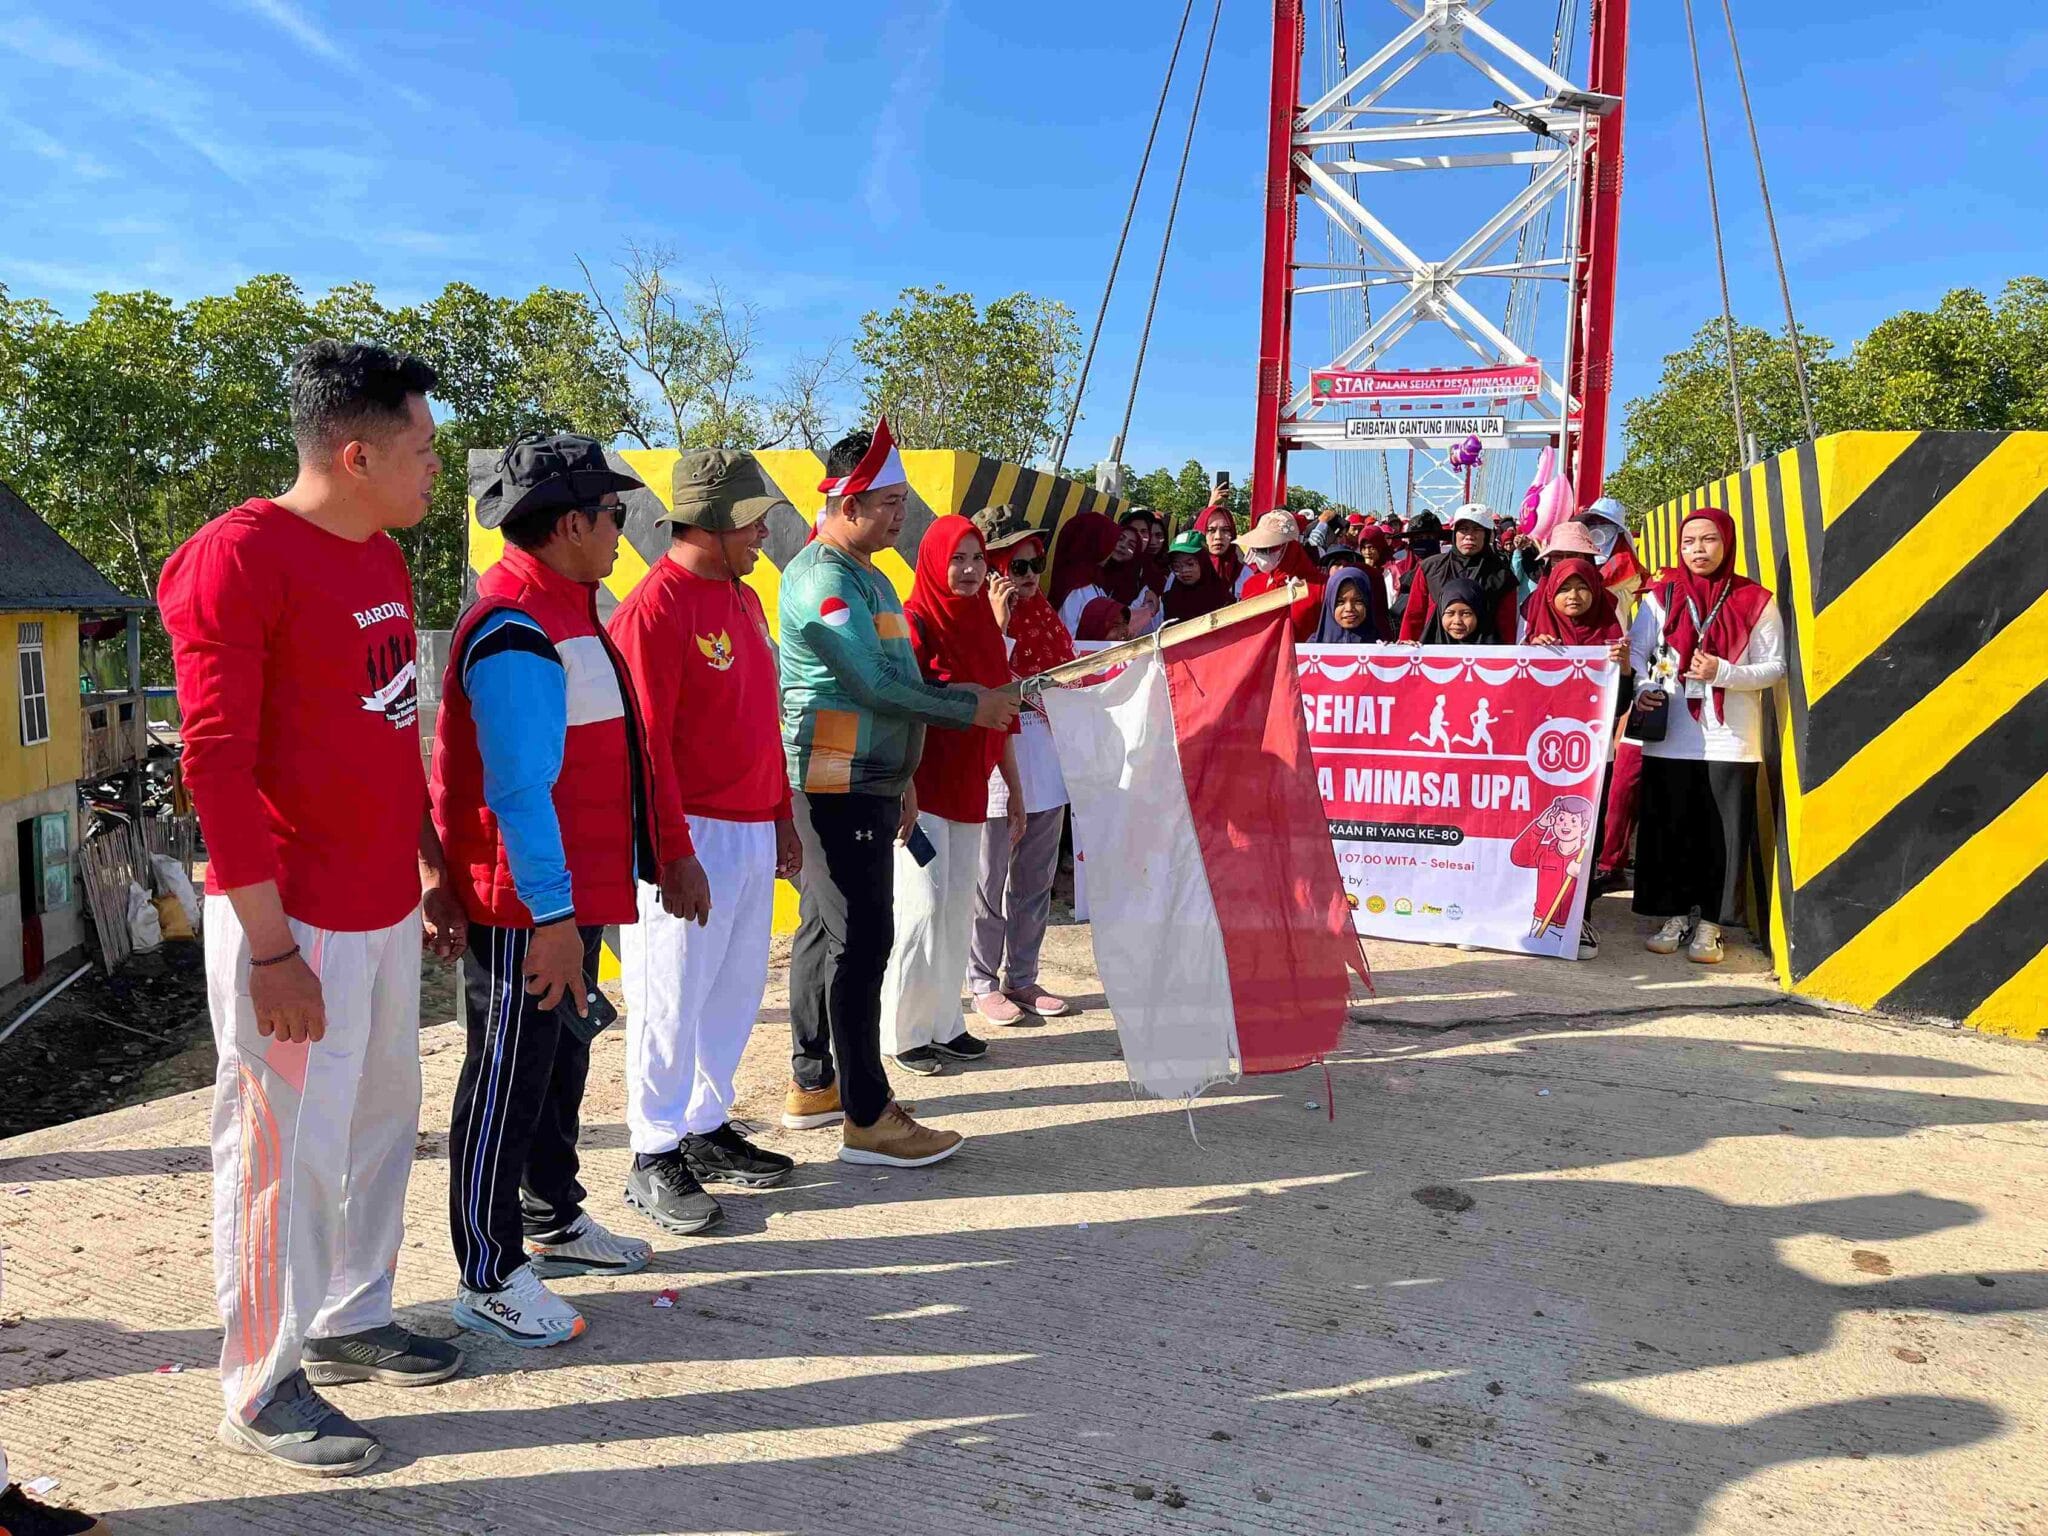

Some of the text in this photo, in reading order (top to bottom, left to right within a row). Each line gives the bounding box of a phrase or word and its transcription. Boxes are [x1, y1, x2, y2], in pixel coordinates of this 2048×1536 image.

[1335, 375, 1536, 393] STAR JALAN SEHAT DESA MINASA UPA
[1351, 419, 1499, 435] JEMBATAN GANTUNG MINASA UPA
[1301, 693, 1396, 735] SEHAT
[1537, 730, 1592, 774] 80
[1317, 767, 1531, 812] A MINASA UPA
[1328, 823, 1364, 837] KAAN
[1366, 826, 1378, 837] RI
[1380, 827, 1416, 839] YANG
[1345, 853, 1382, 865] 07.00
[1384, 855, 1417, 867] WITA
[1430, 858, 1475, 872] Selesai
[1349, 874, 1363, 888] by
[483, 1296, 522, 1325] HOKA
